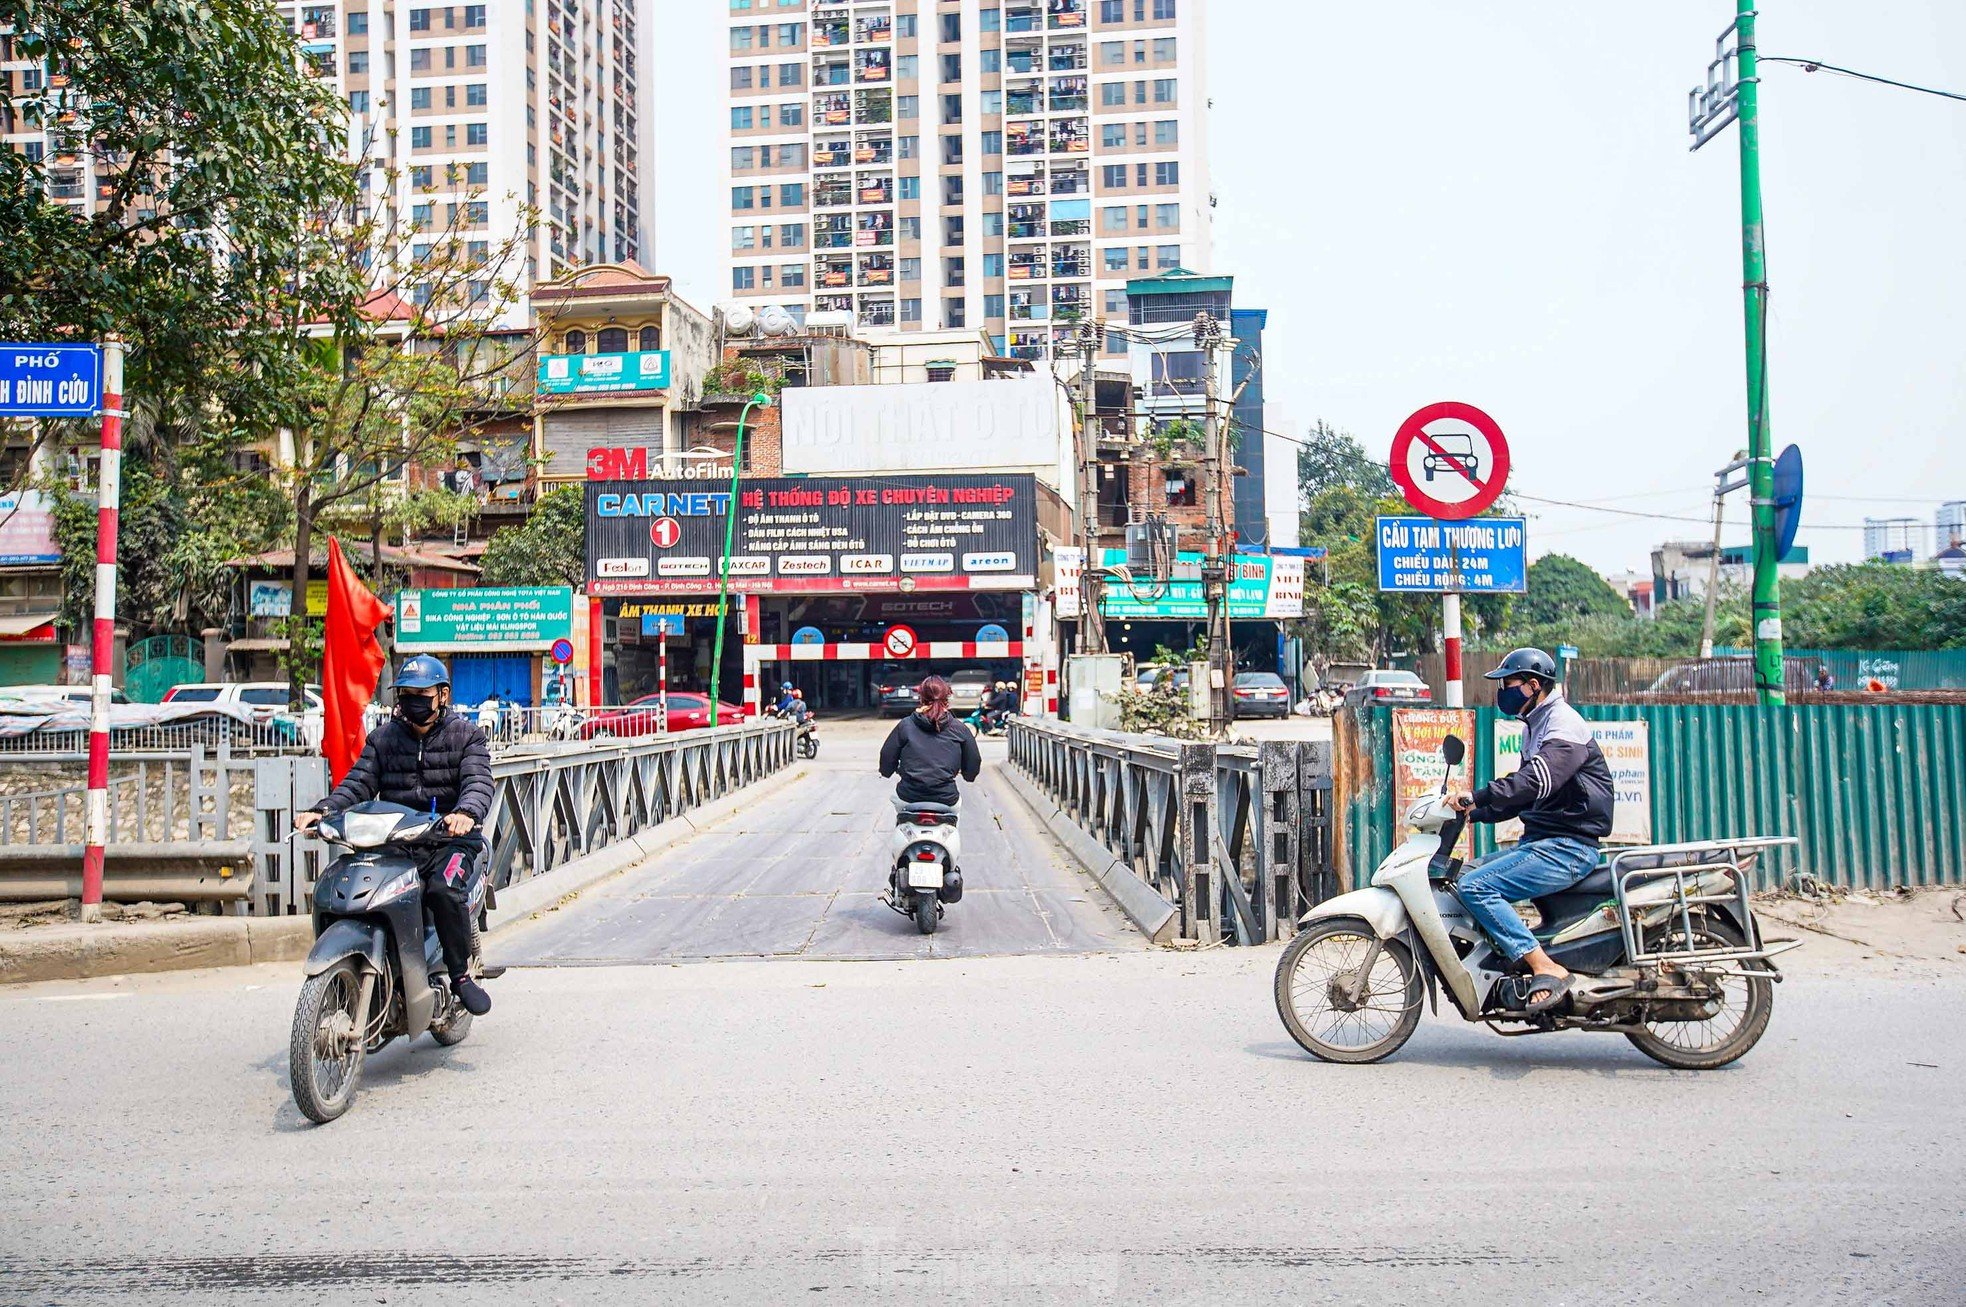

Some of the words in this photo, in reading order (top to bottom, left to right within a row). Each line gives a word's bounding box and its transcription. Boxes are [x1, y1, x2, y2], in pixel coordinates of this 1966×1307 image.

[15, 351, 60, 368] PHỐ
[16, 375, 52, 404] ĐÌNH
[58, 372, 88, 404] CỬU
[586, 447, 647, 481] 3M
[649, 461, 735, 480] AutoFilm
[742, 488, 764, 510] HỆ
[768, 486, 824, 507] THỐNG
[827, 486, 851, 510] ĐỘ
[855, 489, 877, 505] XE
[881, 484, 949, 505] CHUYÊN
[953, 484, 1014, 506] NGHIỆP
[775, 514, 801, 524] THANH
[961, 511, 995, 520] CAMERA
[656, 520, 671, 545] 1
[766, 528, 785, 538] FILM
[832, 528, 848, 537] USA
[1382, 520, 1409, 548] CẦU
[1412, 526, 1440, 552] TẠM
[1443, 525, 1495, 554] THƯỢNG
[1498, 526, 1521, 549] LƯU
[722, 562, 766, 570] AXCAR
[782, 561, 826, 570] Zestech
[850, 560, 882, 568] ICAR
[1394, 553, 1429, 570] CHIỀU
[1462, 557, 1488, 570] 24M
[1242, 561, 1265, 579] BÌNH
[1394, 570, 1430, 586] CHIỀU
[1434, 572, 1471, 589] RỘNG:
[1474, 574, 1493, 586] 4M
[619, 602, 640, 618] ÂM
[686, 604, 703, 616] XE
[880, 602, 953, 612] GOTECH
[1605, 728, 1634, 740] PHẨM
[1618, 746, 1643, 758] SINH
